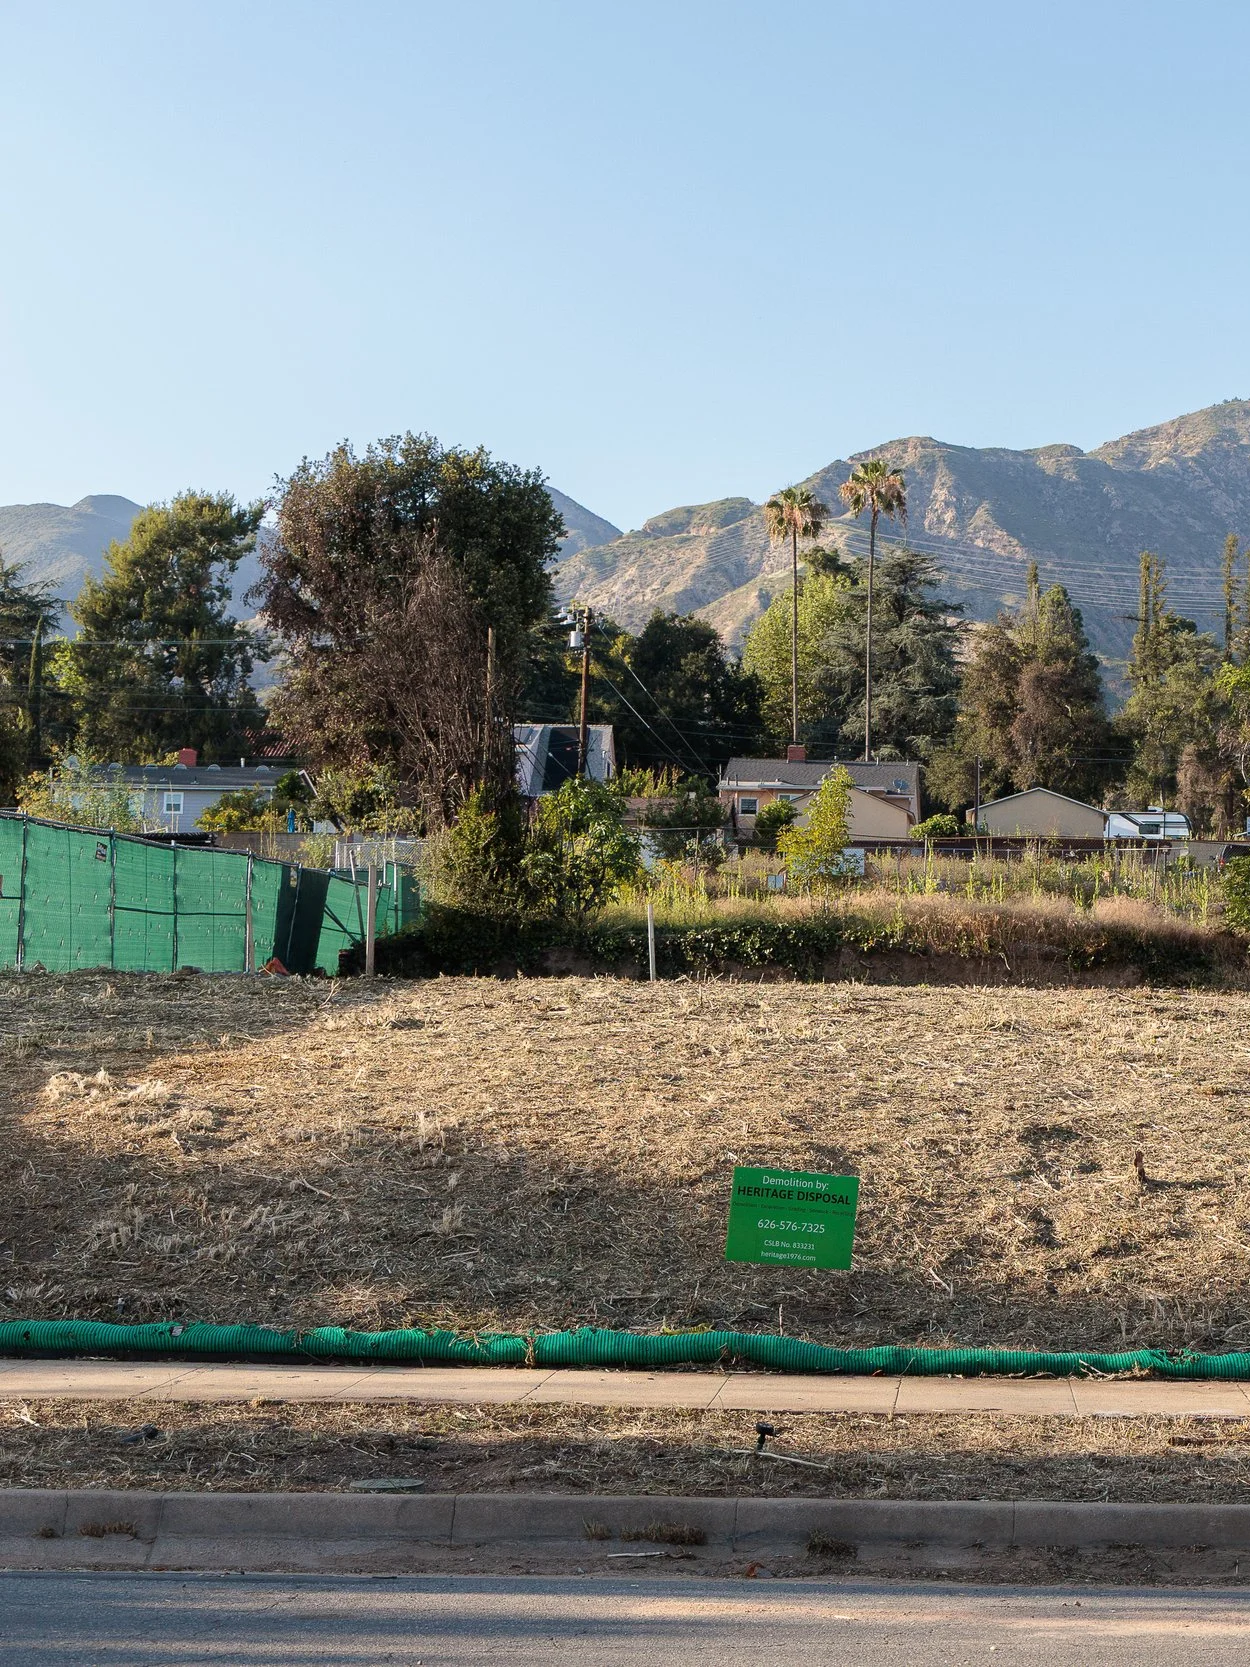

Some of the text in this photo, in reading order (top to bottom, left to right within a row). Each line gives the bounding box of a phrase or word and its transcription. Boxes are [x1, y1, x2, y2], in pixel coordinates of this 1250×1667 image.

[762, 1176, 829, 1191] Demolition by:
[738, 1186, 850, 1205] HERITAGE DISPOSAL
[758, 1219, 825, 1233] 626-576-7325
[764, 1240, 780, 1248] CSLB
[792, 1242, 814, 1250] 833231
[760, 1250, 816, 1262] heritage1976.com
